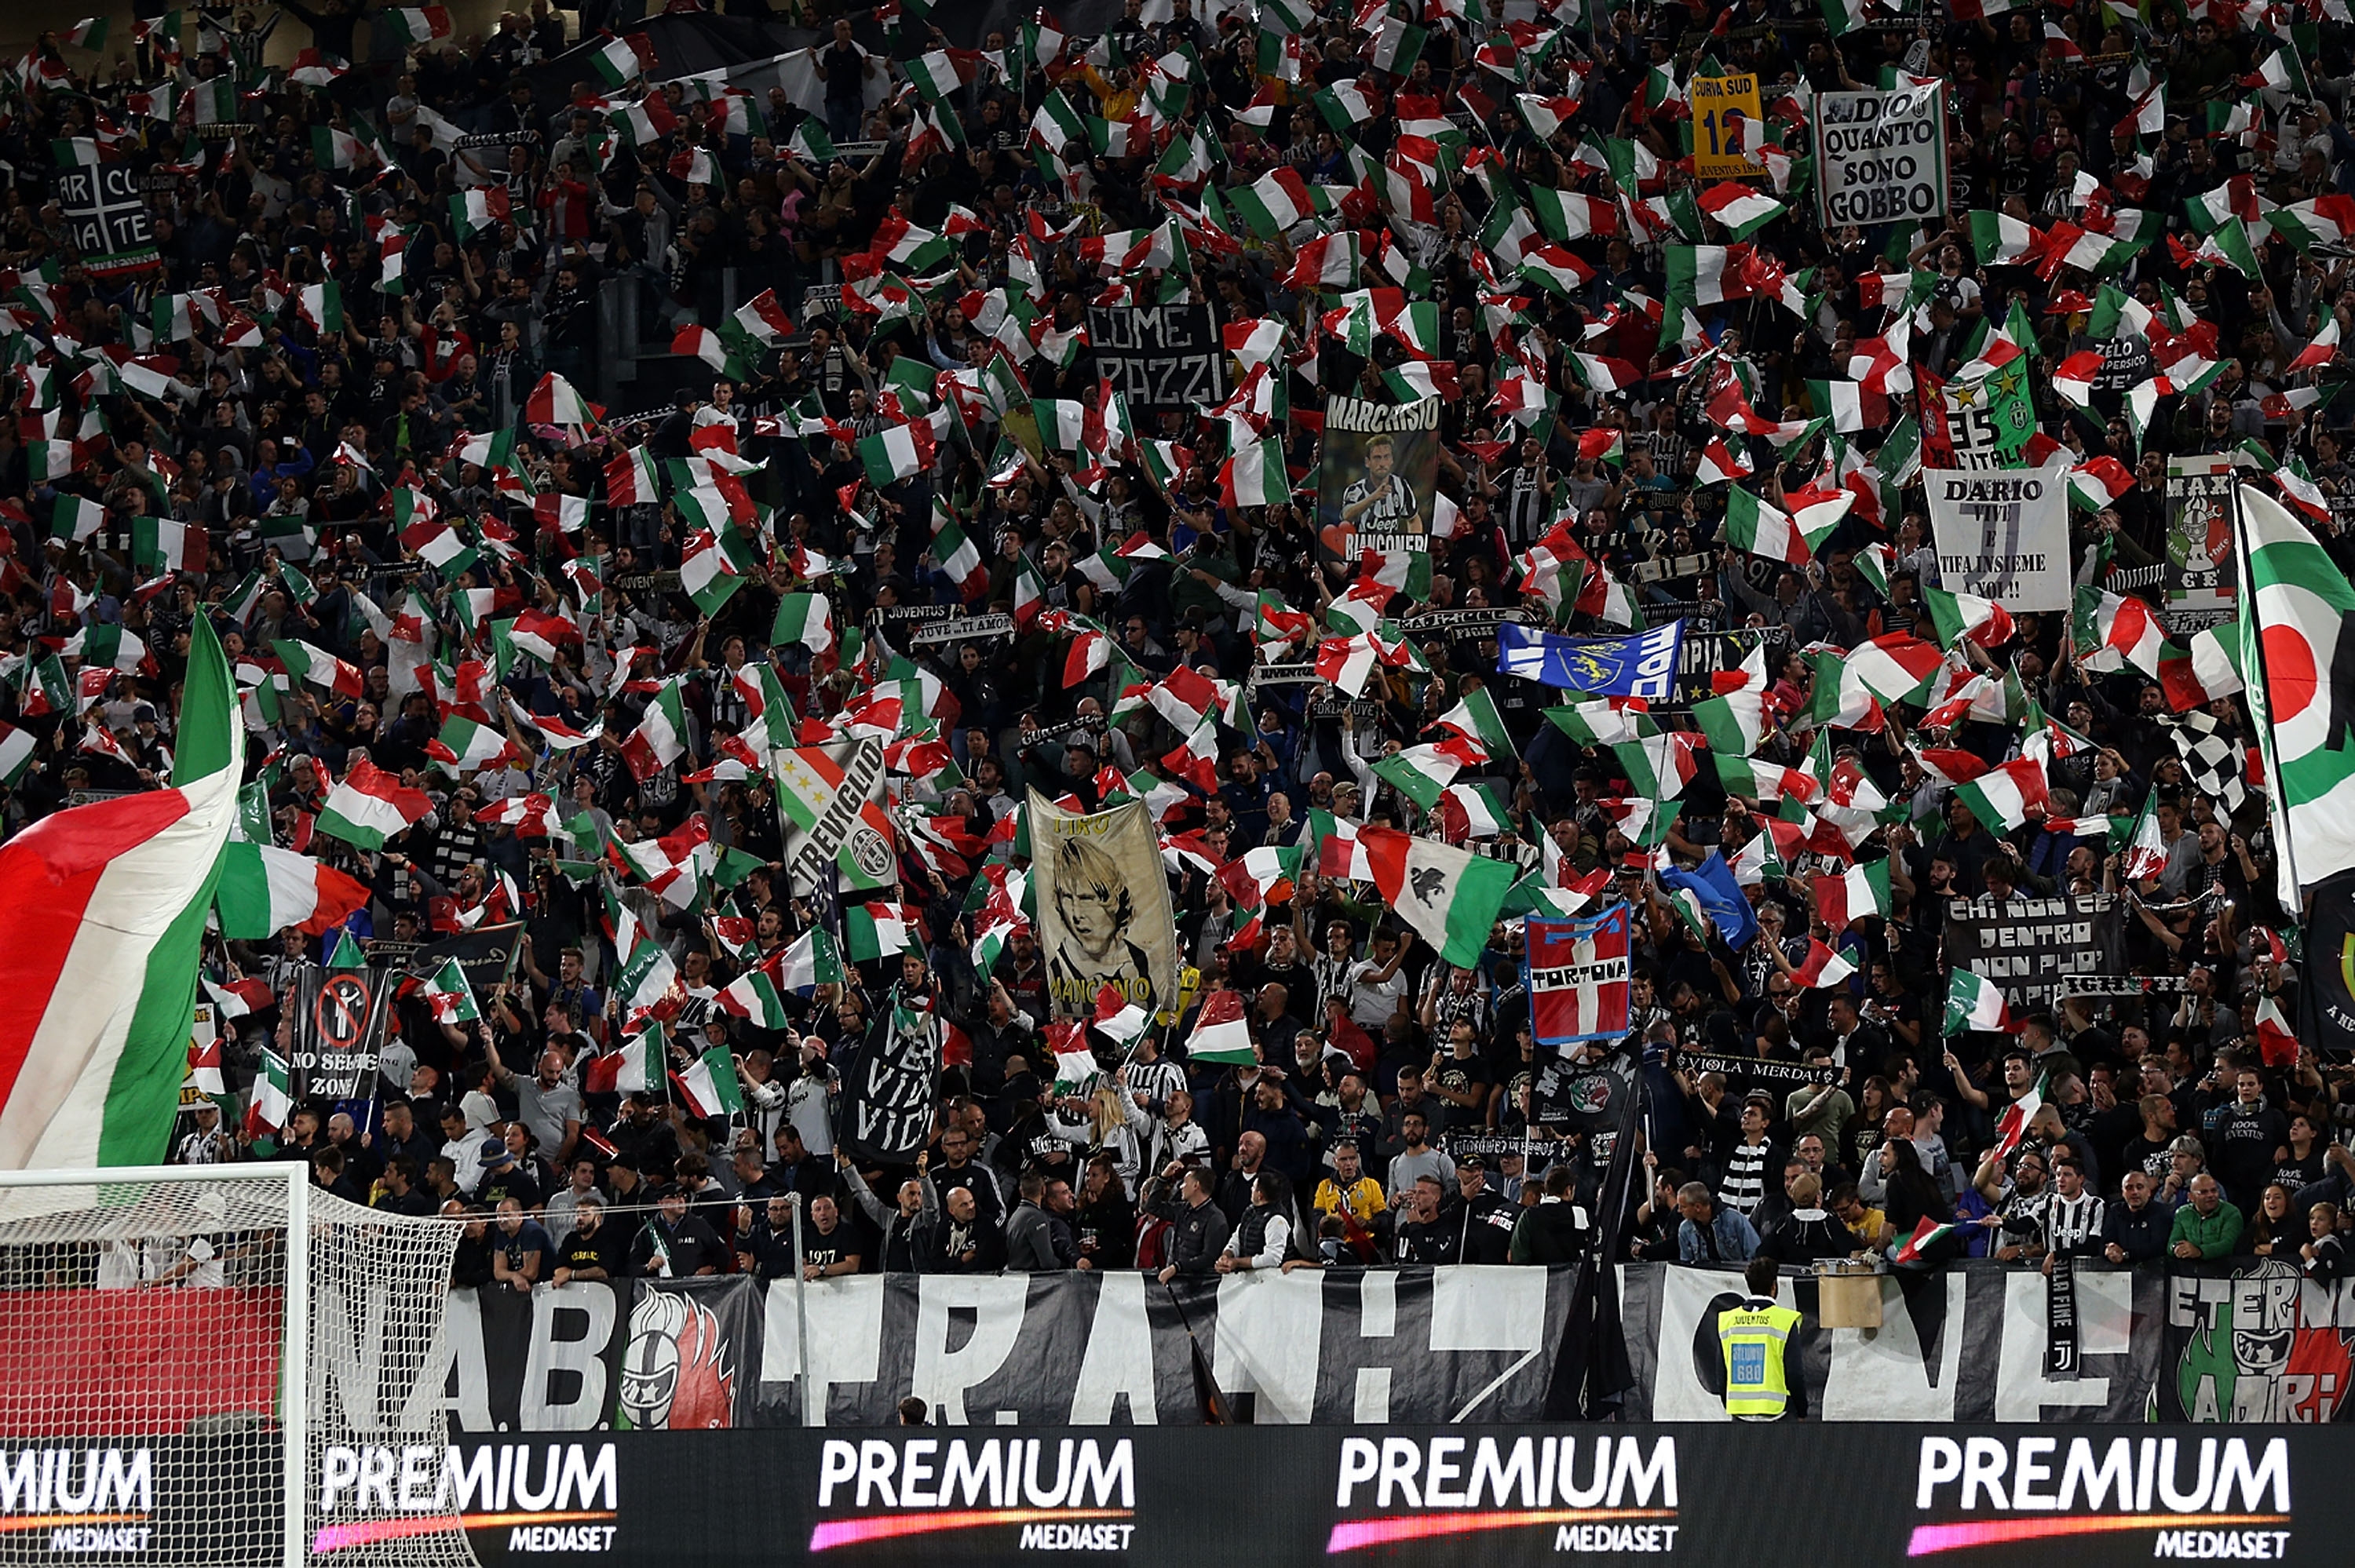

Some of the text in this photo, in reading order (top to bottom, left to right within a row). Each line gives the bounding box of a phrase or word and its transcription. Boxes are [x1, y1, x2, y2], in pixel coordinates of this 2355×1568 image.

[1696, 81, 1723, 97] CURVA
[1726, 78, 1751, 95] SUD
[1854, 93, 1913, 123] DIO
[1826, 119, 1934, 162] QUANTO
[1700, 162, 1740, 177] JUVENTUS
[1844, 156, 1917, 186] SONO
[1828, 183, 1934, 222] GOBBO
[113, 213, 154, 245] TE
[1086, 306, 1193, 349] COME
[2094, 341, 2133, 359] ZELO
[2106, 353, 2148, 371] PERSICO
[1095, 352, 1224, 406] PAZZI
[1325, 394, 1440, 433] MARCHISIO
[1652, 452, 1675, 461] Jeep
[1944, 480, 2043, 501] DARIO
[2166, 475, 2230, 498] MAX
[1366, 518, 1399, 533] Jeep
[1940, 554, 2046, 573] TIFA INSIEME
[888, 604, 946, 620] JUVENTUS
[918, 625, 951, 639] JUVE
[1349, 701, 1376, 717] UVE
[790, 741, 882, 885] TREVIGLIO
[1950, 899, 1998, 921] CHI
[2006, 897, 2067, 918] NON
[1979, 921, 2092, 949] DENTRO
[1532, 961, 1627, 989] TORTONA
[1970, 954, 2031, 978] NON
[1050, 977, 1151, 1005] MANCNO
[291, 1052, 317, 1070] NO
[1689, 1056, 1743, 1074] VIOLA
[1751, 1063, 1820, 1084] MERDA!
[2231, 1120, 2259, 1129] 100%
[2053, 1225, 2082, 1240] Jeep
[1733, 1315, 1770, 1326] JUVENTUS
[2053, 1295, 2072, 1329] FINE
[1736, 1364, 1762, 1381] 680
[321, 1442, 618, 1512] PREMIUM
[818, 1439, 1136, 1509] PREMIUM
[1337, 1435, 1679, 1509] PREMIUM
[1916, 1436, 2291, 1513] PREMIUM
[51, 1527, 152, 1552] MEDIASET
[509, 1526, 616, 1552] MEDIASET
[1020, 1524, 1136, 1551] MEDIASET
[1555, 1524, 1679, 1553] MEDIASET
[2155, 1530, 2291, 1559] MEDIASET
